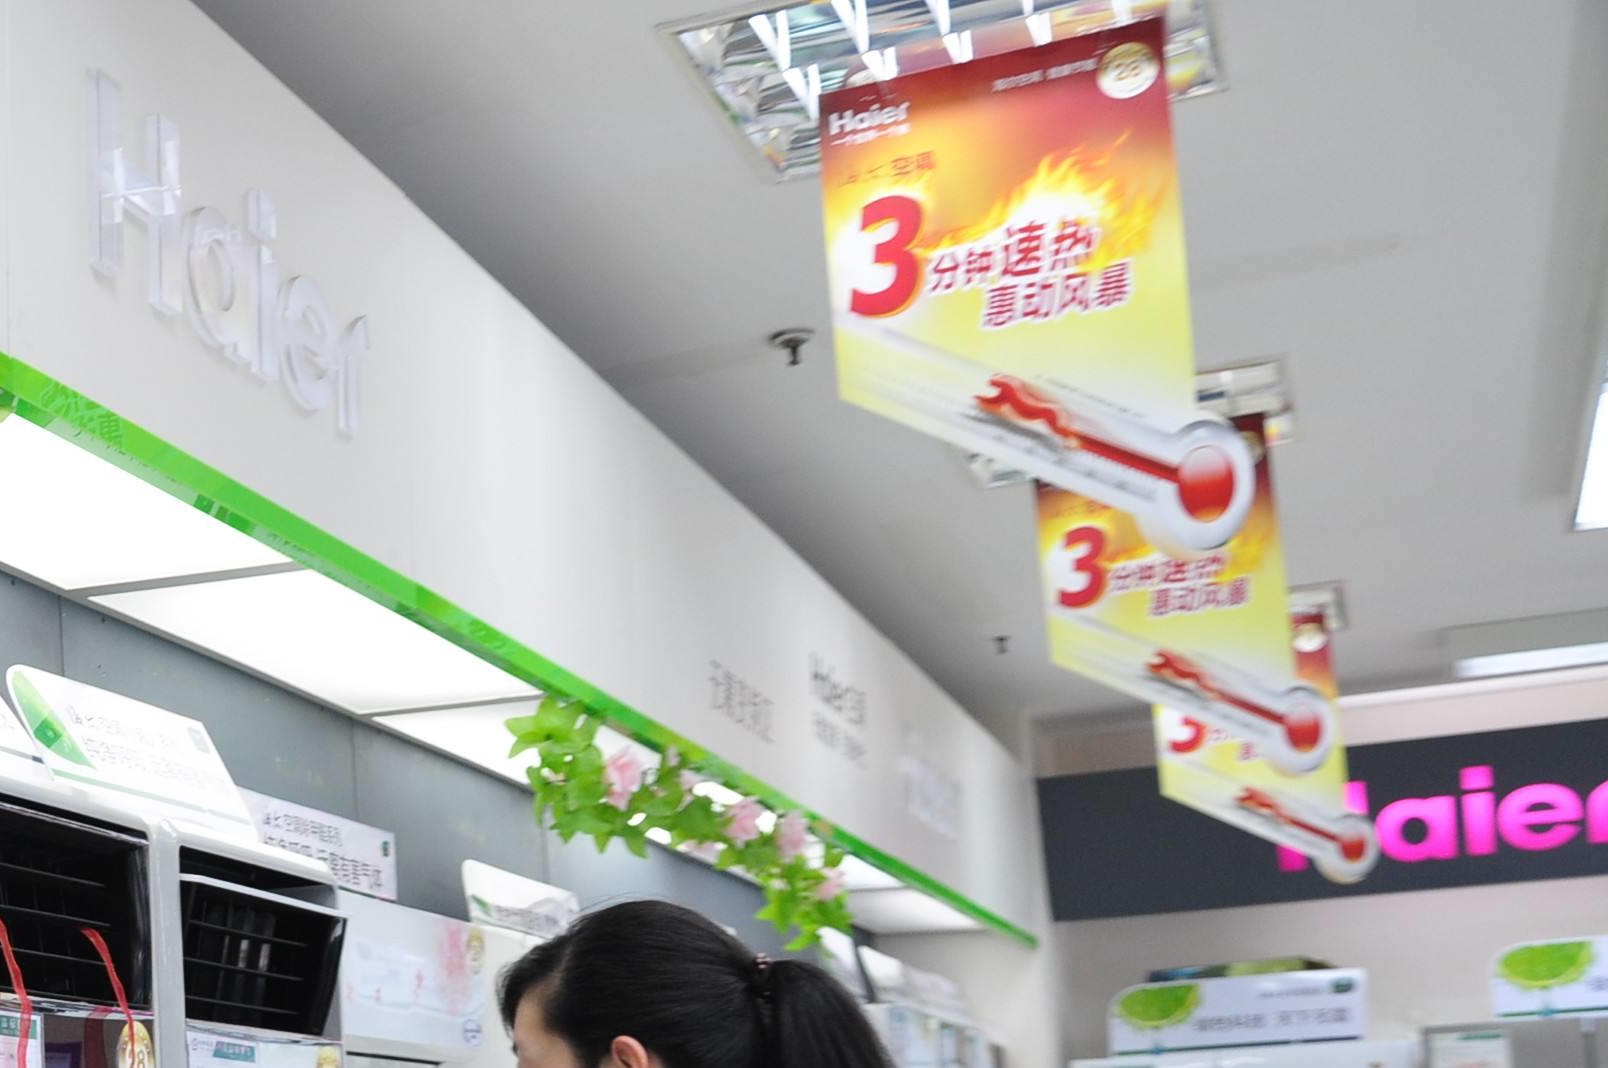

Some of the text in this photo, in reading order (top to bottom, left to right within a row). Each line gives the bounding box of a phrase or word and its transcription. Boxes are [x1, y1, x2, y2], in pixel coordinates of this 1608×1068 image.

[828, 102, 910, 135] Haier
[87, 67, 371, 440] Haier
[849, 195, 924, 318] 3
[1058, 525, 1106, 608] 3
[1277, 765, 1608, 873] aie
